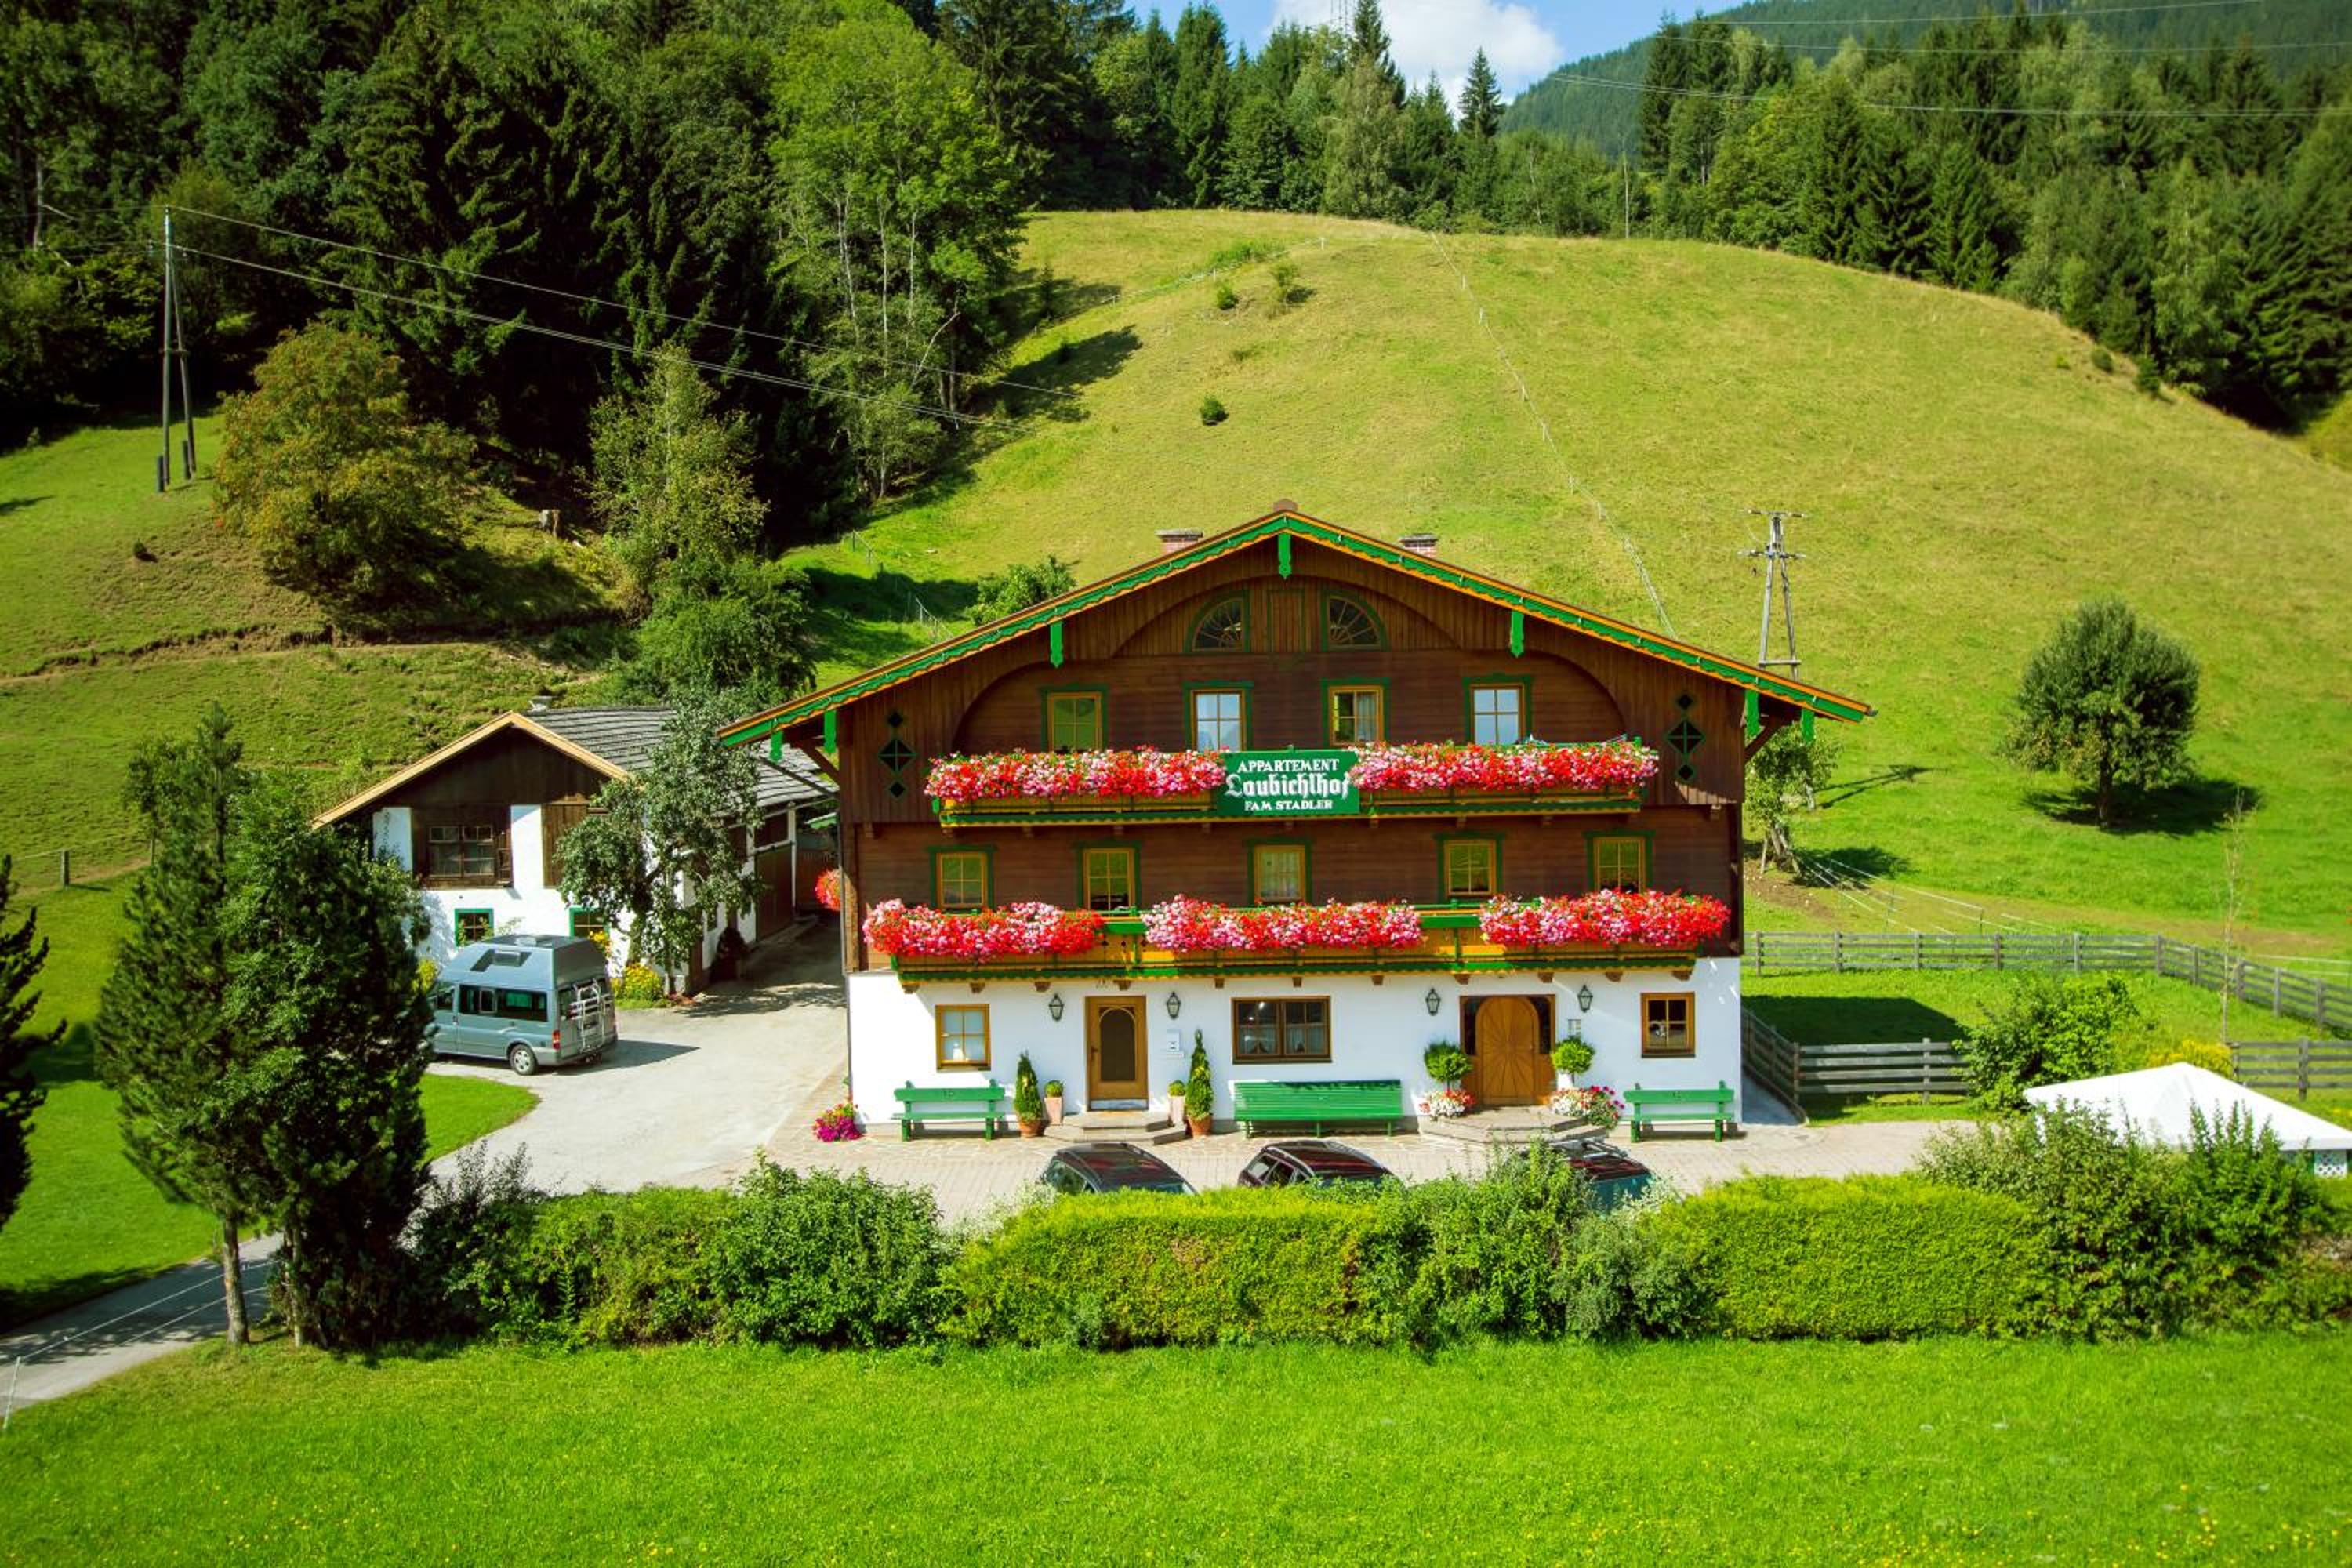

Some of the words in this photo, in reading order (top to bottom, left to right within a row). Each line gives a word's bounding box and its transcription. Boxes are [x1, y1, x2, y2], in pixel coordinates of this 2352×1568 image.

[1237, 759, 1339, 772] APPARTEMENT
[1225, 772, 1350, 800] Laubichlhof
[1276, 800, 1334, 811] STADLER
